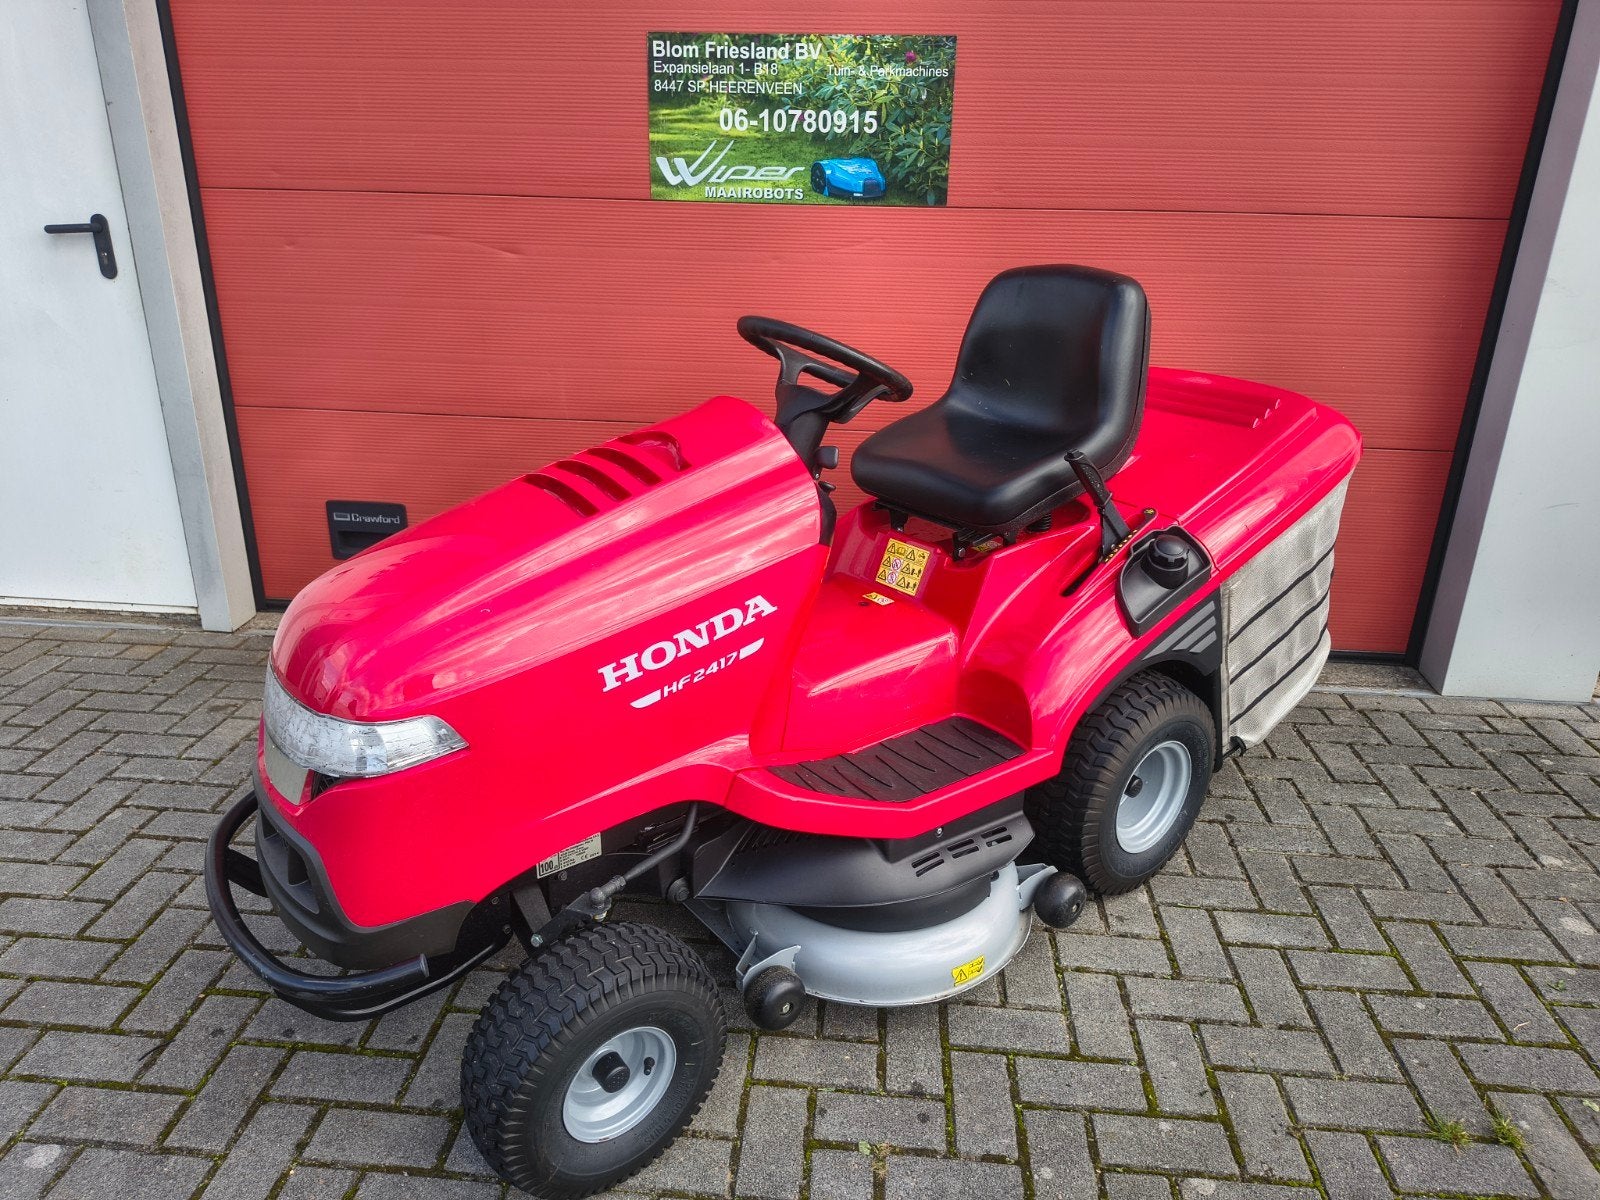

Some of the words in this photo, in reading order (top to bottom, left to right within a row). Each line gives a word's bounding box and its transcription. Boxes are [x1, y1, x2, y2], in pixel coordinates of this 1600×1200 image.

[652, 40, 699, 58] Blom
[705, 42, 789, 60] Friesland
[795, 43, 823, 60] BV
[653, 61, 735, 76] Expansielaan
[754, 63, 778, 75] B18
[858, 66, 867, 76] &
[870, 65, 949, 77] Parkmachines
[654, 80, 684, 92] 8447
[687, 81, 705, 93] SP
[709, 82, 803, 95] HEERENVEEN
[719, 108, 878, 134] 06-10780915
[704, 186, 804, 201] MAAIROBOTS
[351, 513, 400, 524] Crawford
[597, 594, 778, 693] HONDA
[540, 860, 553, 873] 100
